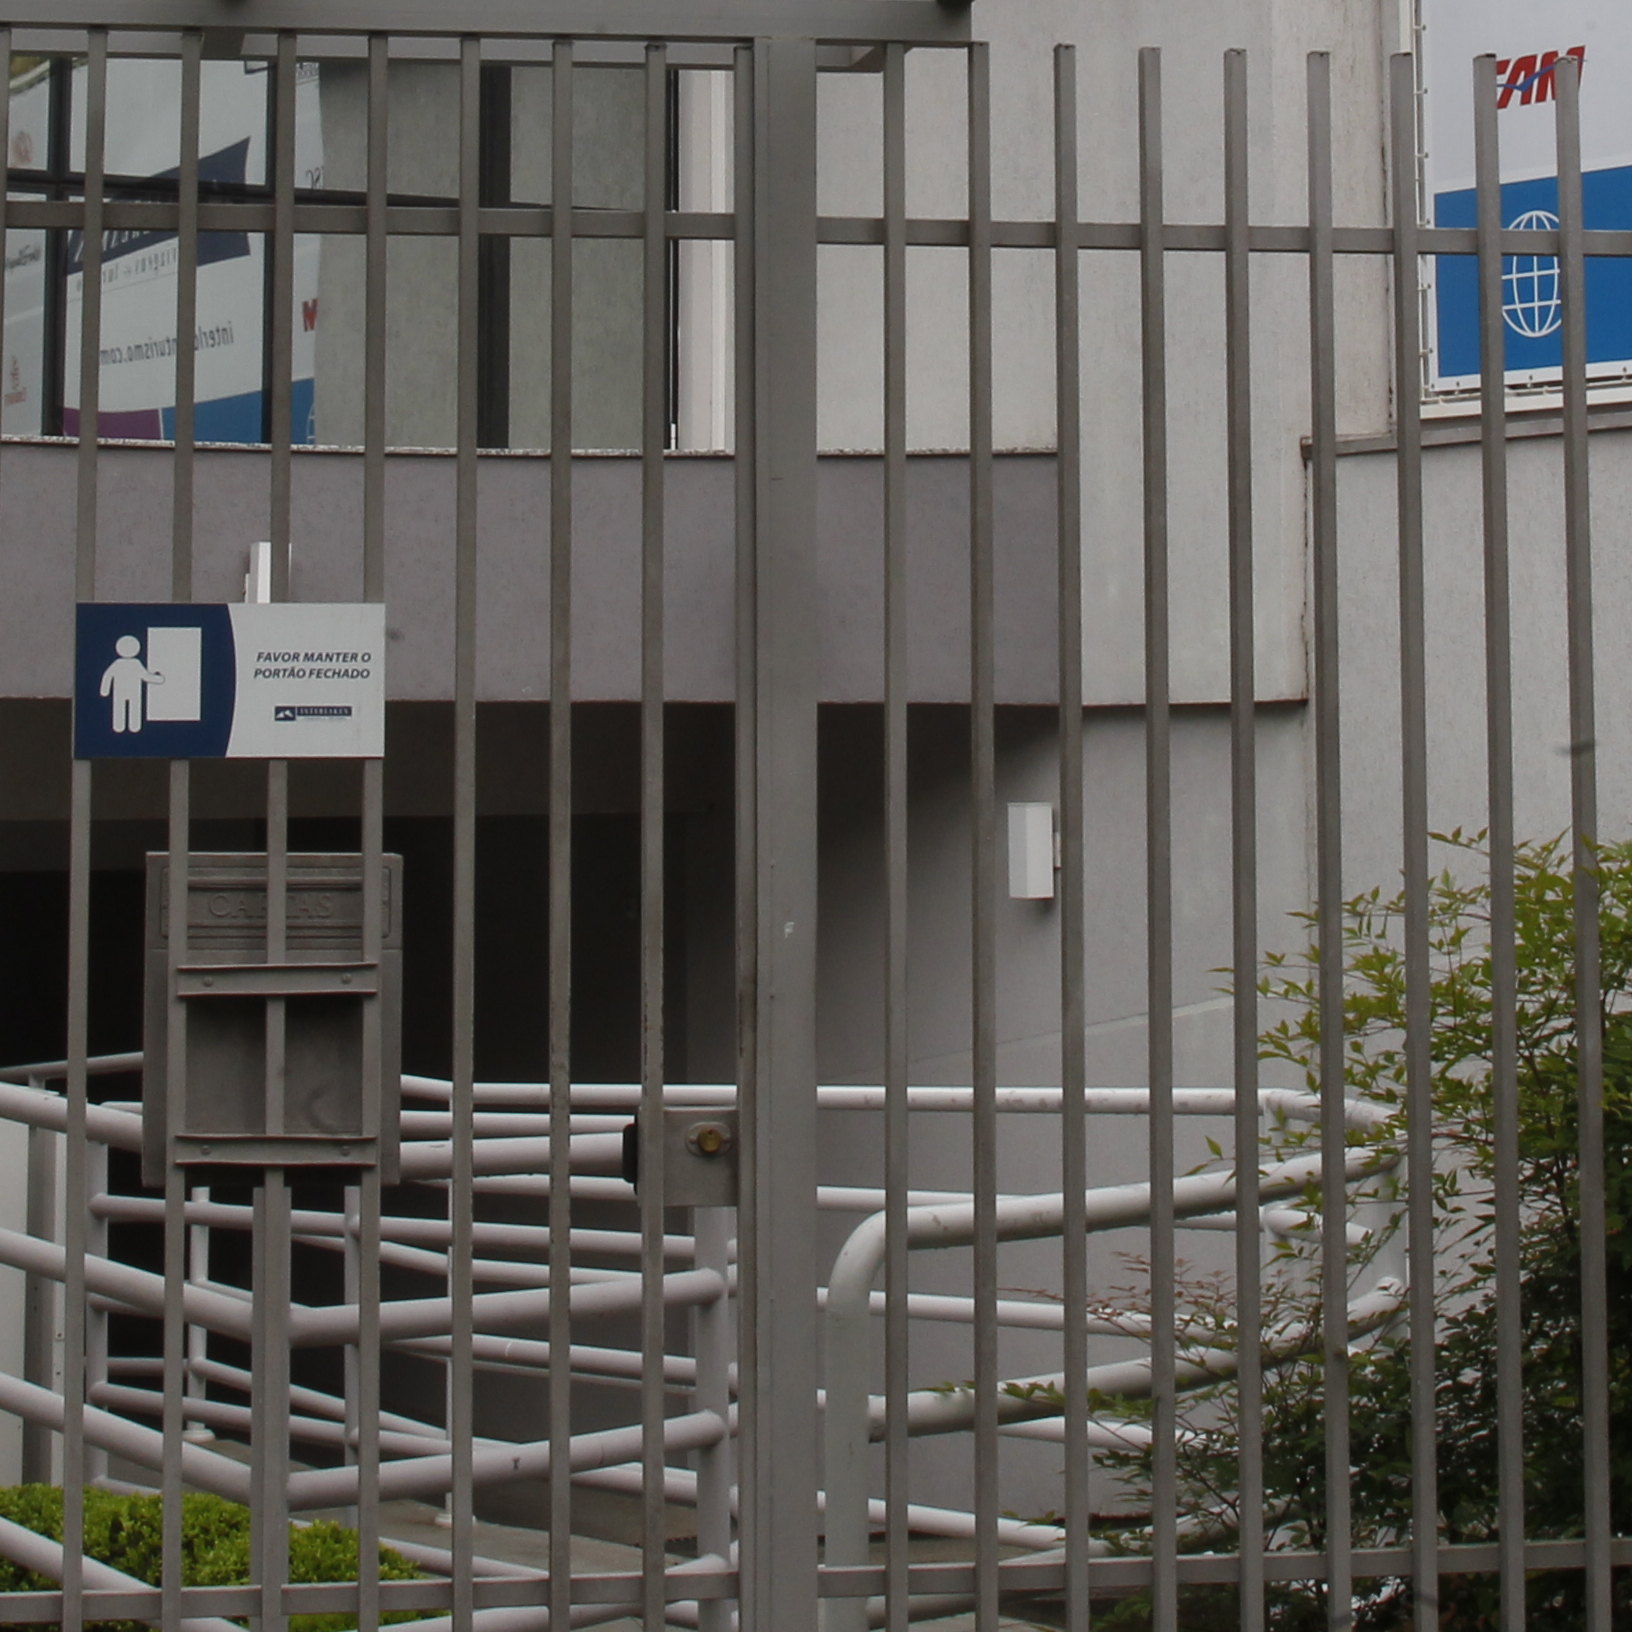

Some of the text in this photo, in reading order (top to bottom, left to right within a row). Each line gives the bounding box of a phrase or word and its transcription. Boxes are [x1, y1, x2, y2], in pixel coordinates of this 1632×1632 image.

[256, 652, 371, 663] FAVOR MANTER O
[253, 666, 370, 679] PORTÃO FECHADO
